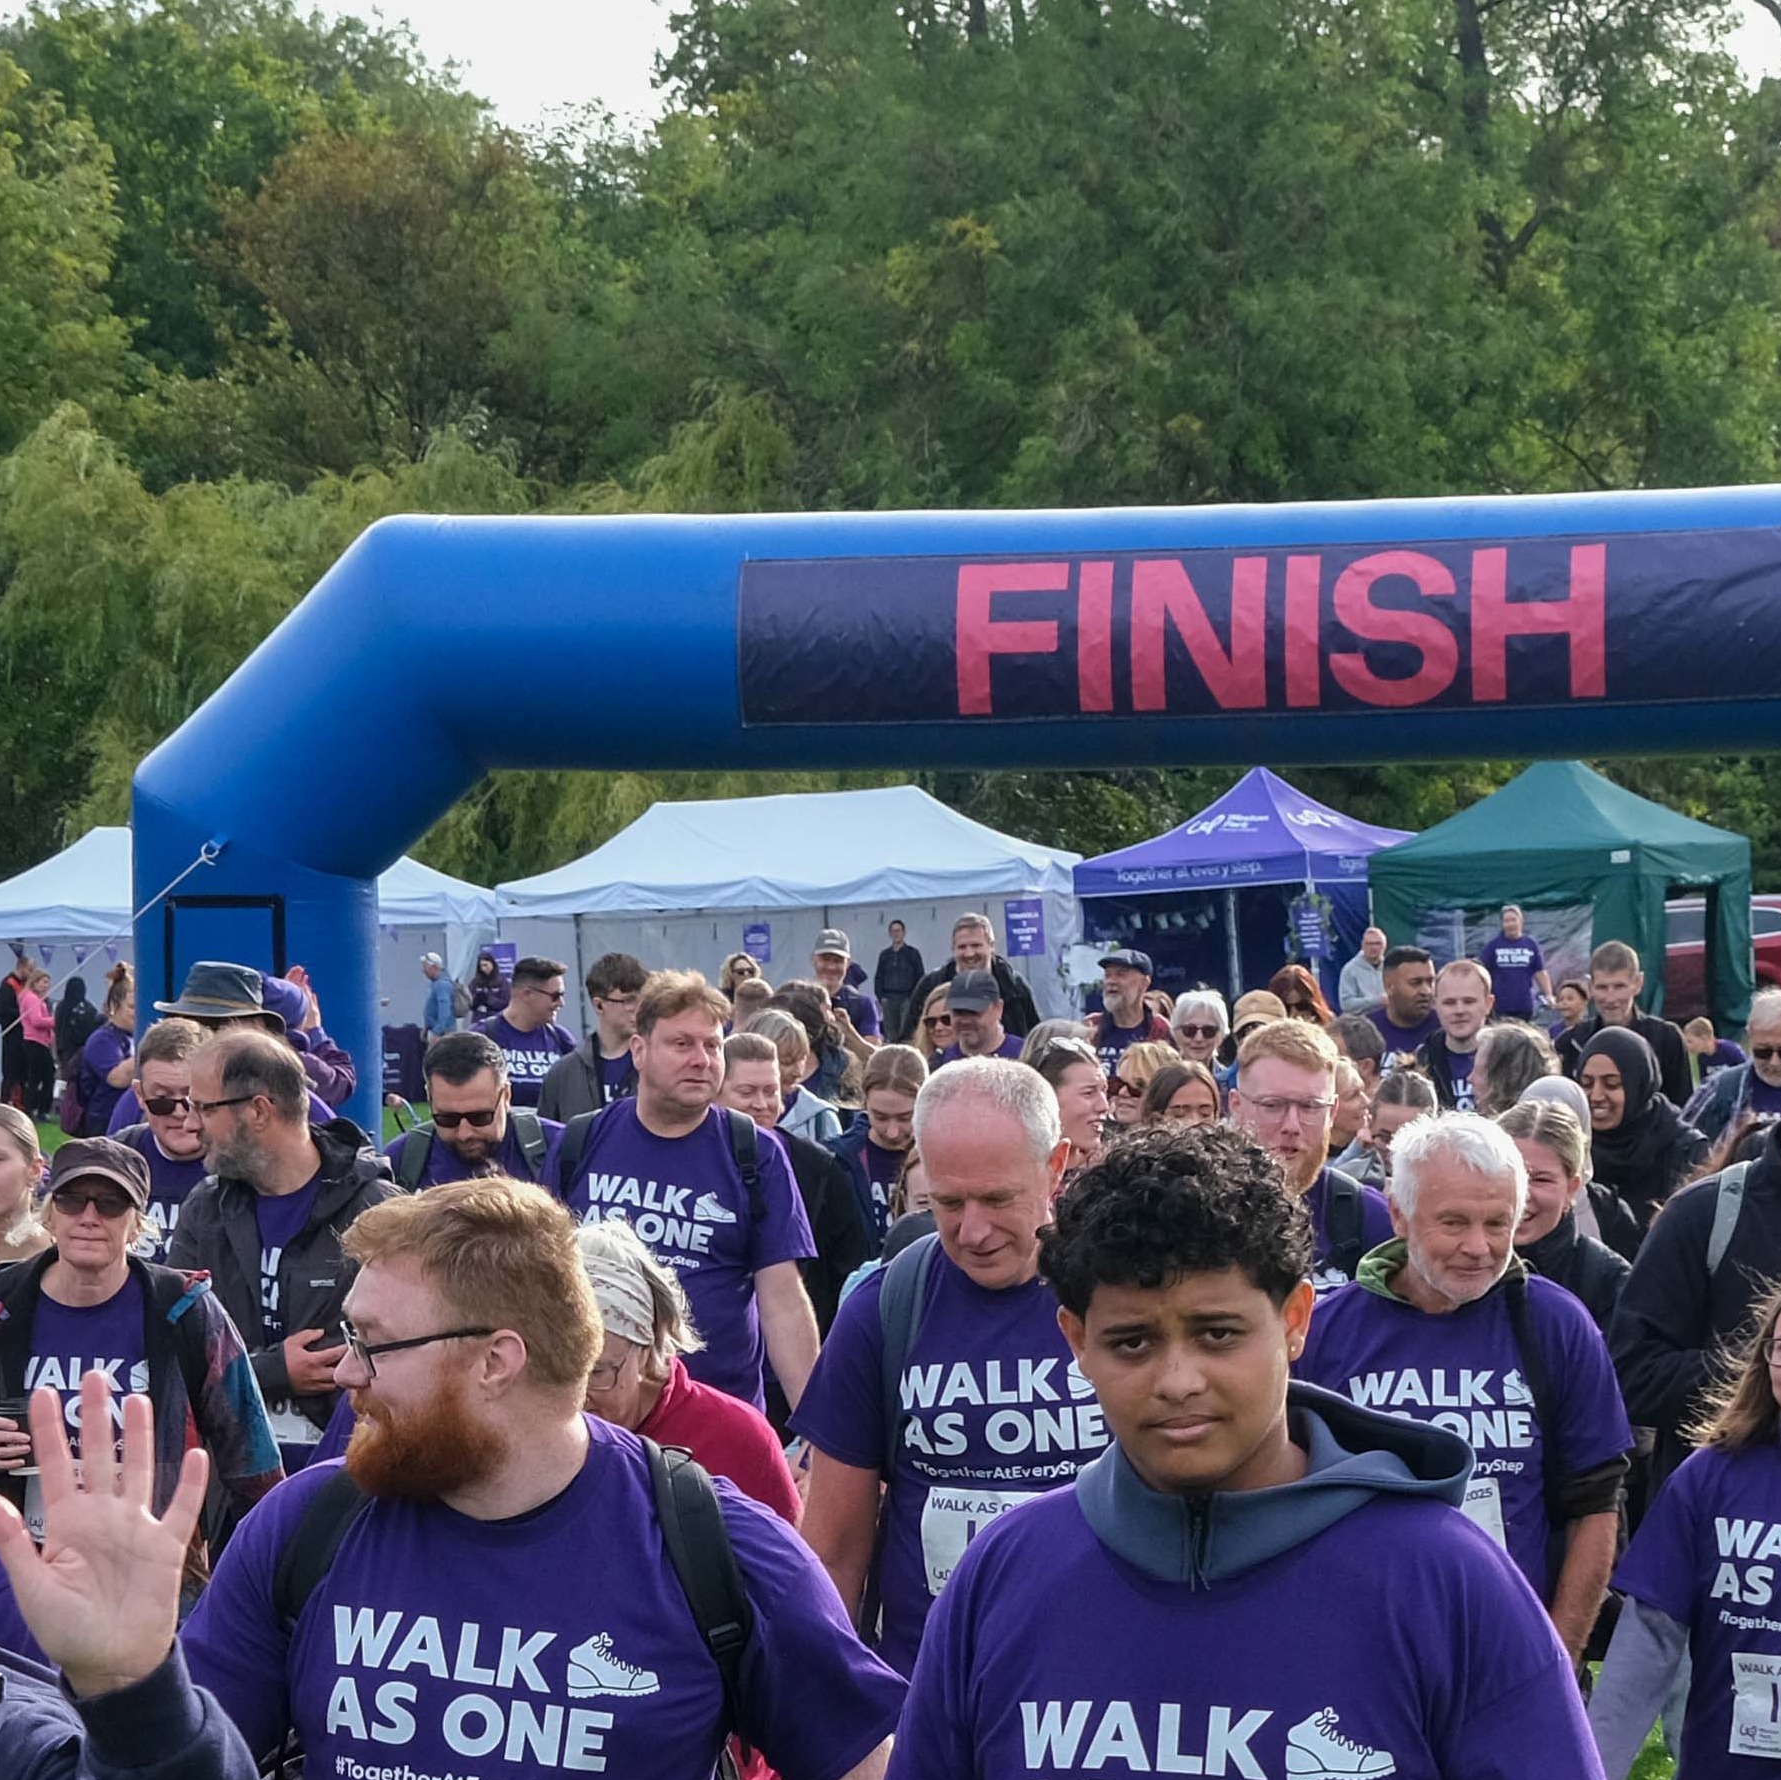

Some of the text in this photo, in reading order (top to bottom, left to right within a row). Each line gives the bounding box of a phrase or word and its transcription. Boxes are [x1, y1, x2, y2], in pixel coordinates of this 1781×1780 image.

[955, 543, 1608, 716] FINISH
[588, 1173, 693, 1218] WALK
[635, 1212, 715, 1254] ONE
[899, 1357, 1063, 1411] WALK
[1348, 1367, 1497, 1408] WALK
[904, 1403, 1110, 1457] AS ONE
[931, 1496, 973, 1513] WALK
[975, 1500, 998, 1514] AS
[1709, 1561, 1774, 1606] AS
[332, 1603, 558, 1694] WALK
[1738, 1661, 1775, 1677] WALK
[326, 1675, 614, 1774] AS ONE
